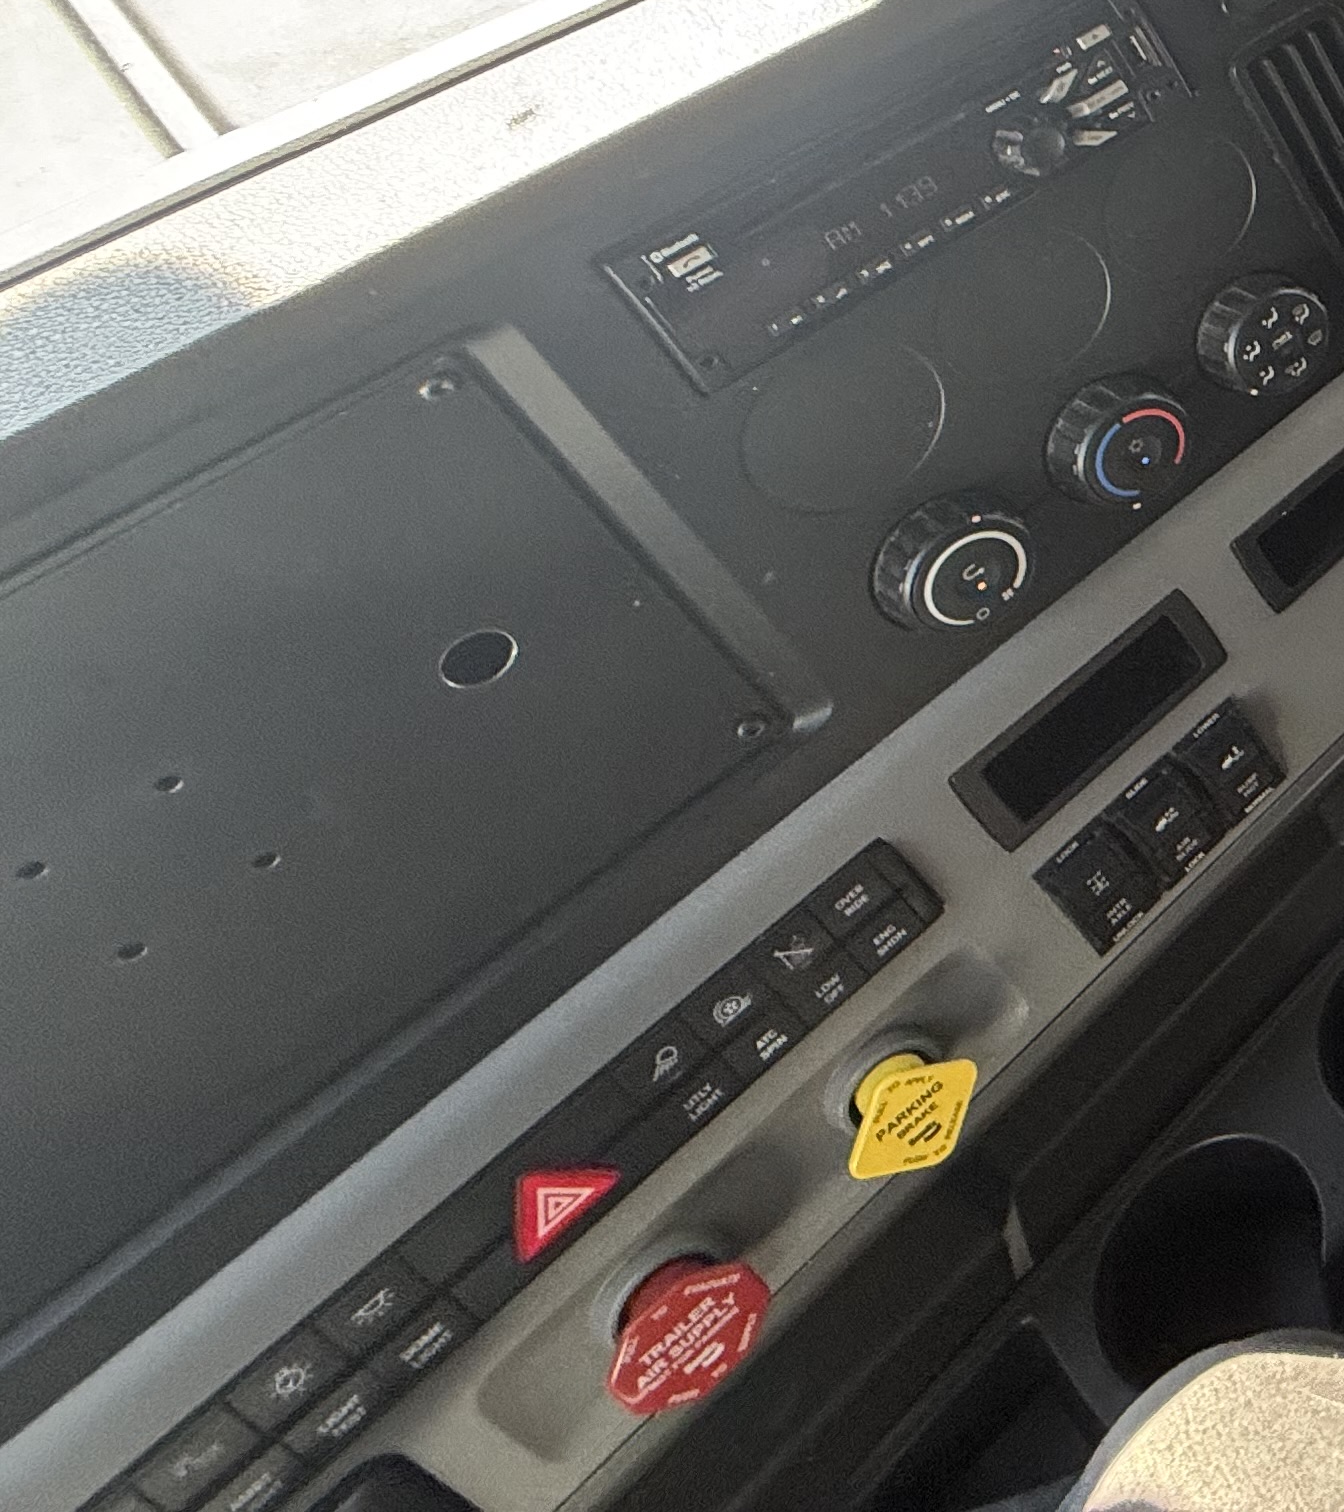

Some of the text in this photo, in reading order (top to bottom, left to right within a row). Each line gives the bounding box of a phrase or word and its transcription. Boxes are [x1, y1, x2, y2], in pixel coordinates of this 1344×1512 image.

[1193, 713, 1219, 738] LOWER
[835, 885, 864, 910] OVER
[845, 895, 868, 916] RIDE
[873, 925, 896, 945] ENG
[877, 929, 907, 956] SHDN
[815, 974, 840, 998] LOW
[756, 1030, 777, 1050] ATC
[760, 1035, 787, 1060] SPIN
[689, 1089, 723, 1121] LIGHT
[876, 1082, 943, 1142] PARKING
[897, 1102, 938, 1139] BRAKE
[638, 1293, 734, 1389] AIR SUPPLY
[640, 1298, 714, 1364] TRAILER
